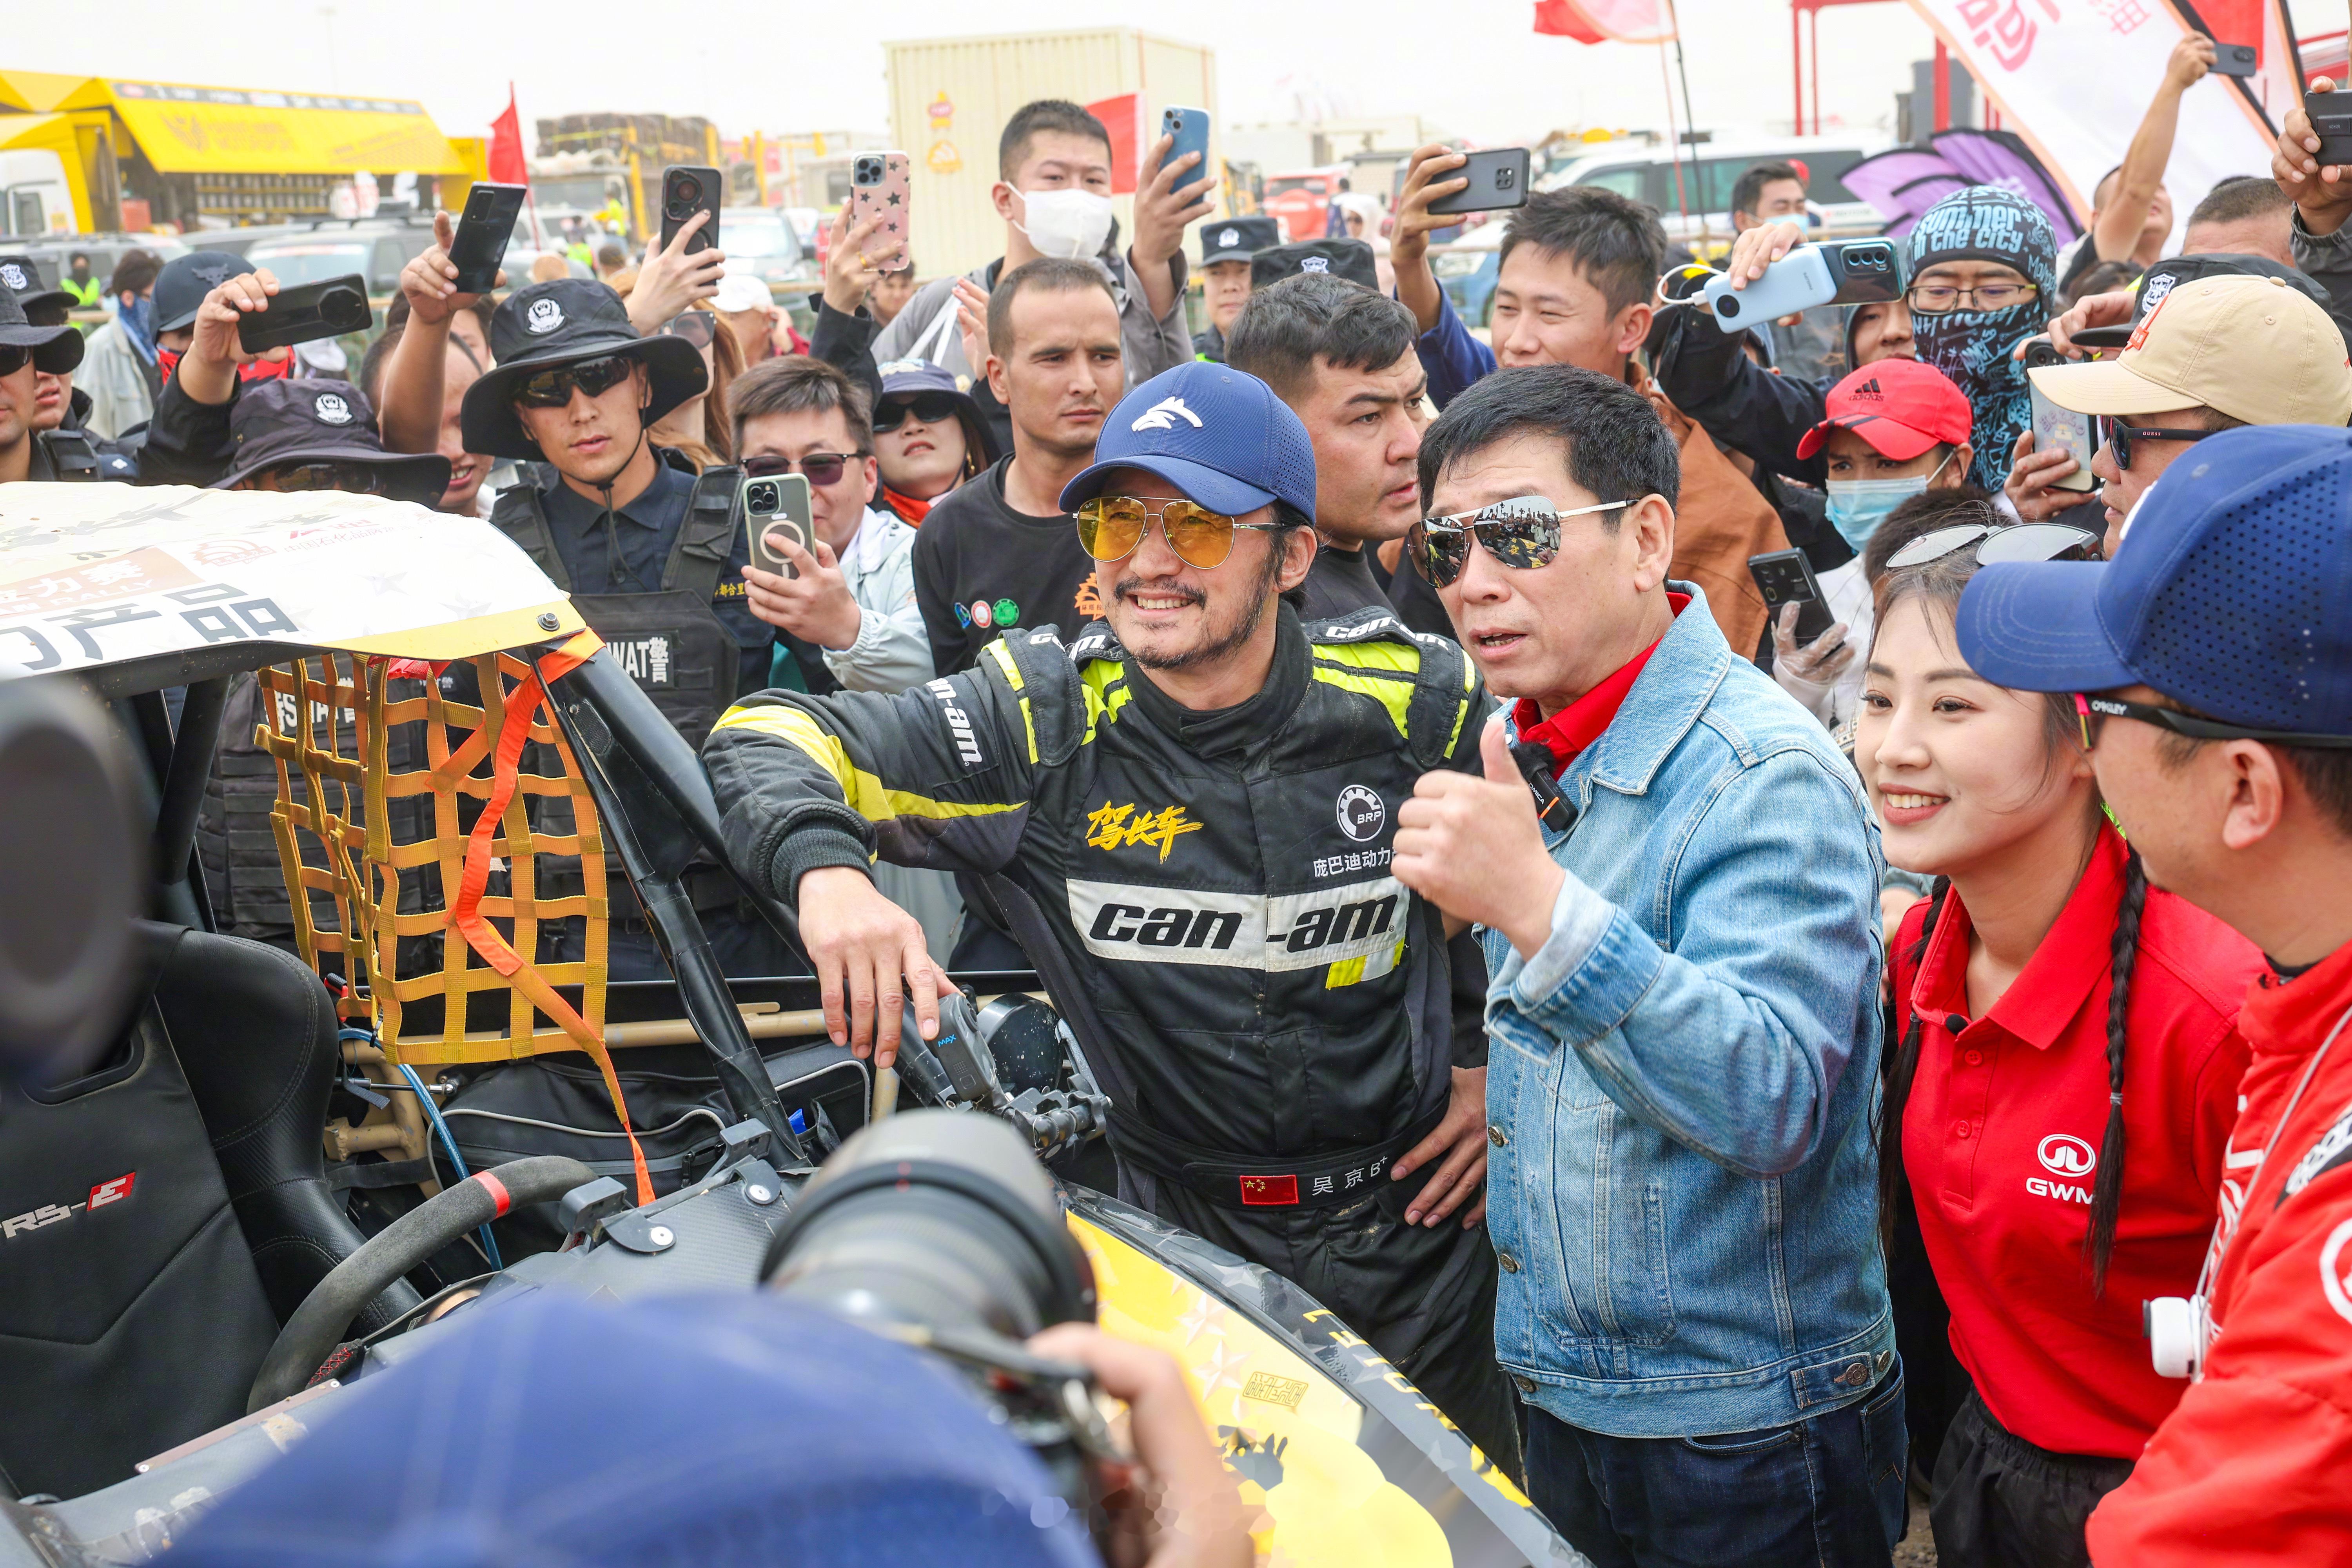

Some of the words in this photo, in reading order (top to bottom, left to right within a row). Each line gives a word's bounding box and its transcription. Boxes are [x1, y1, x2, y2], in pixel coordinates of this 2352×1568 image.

[1931, 228, 1971, 252] the
[1849, 392, 1884, 401] adidas
[50, 579, 154, 606] RALLY
[606, 637, 669, 683] WAT警
[1529, 782, 1544, 805] OMICA
[1357, 810, 1382, 824] BRP
[1313, 847, 1397, 878] 庞巴迪动力
[938, 1034, 956, 1047] MAX
[2026, 1177, 2093, 1205] GWM
